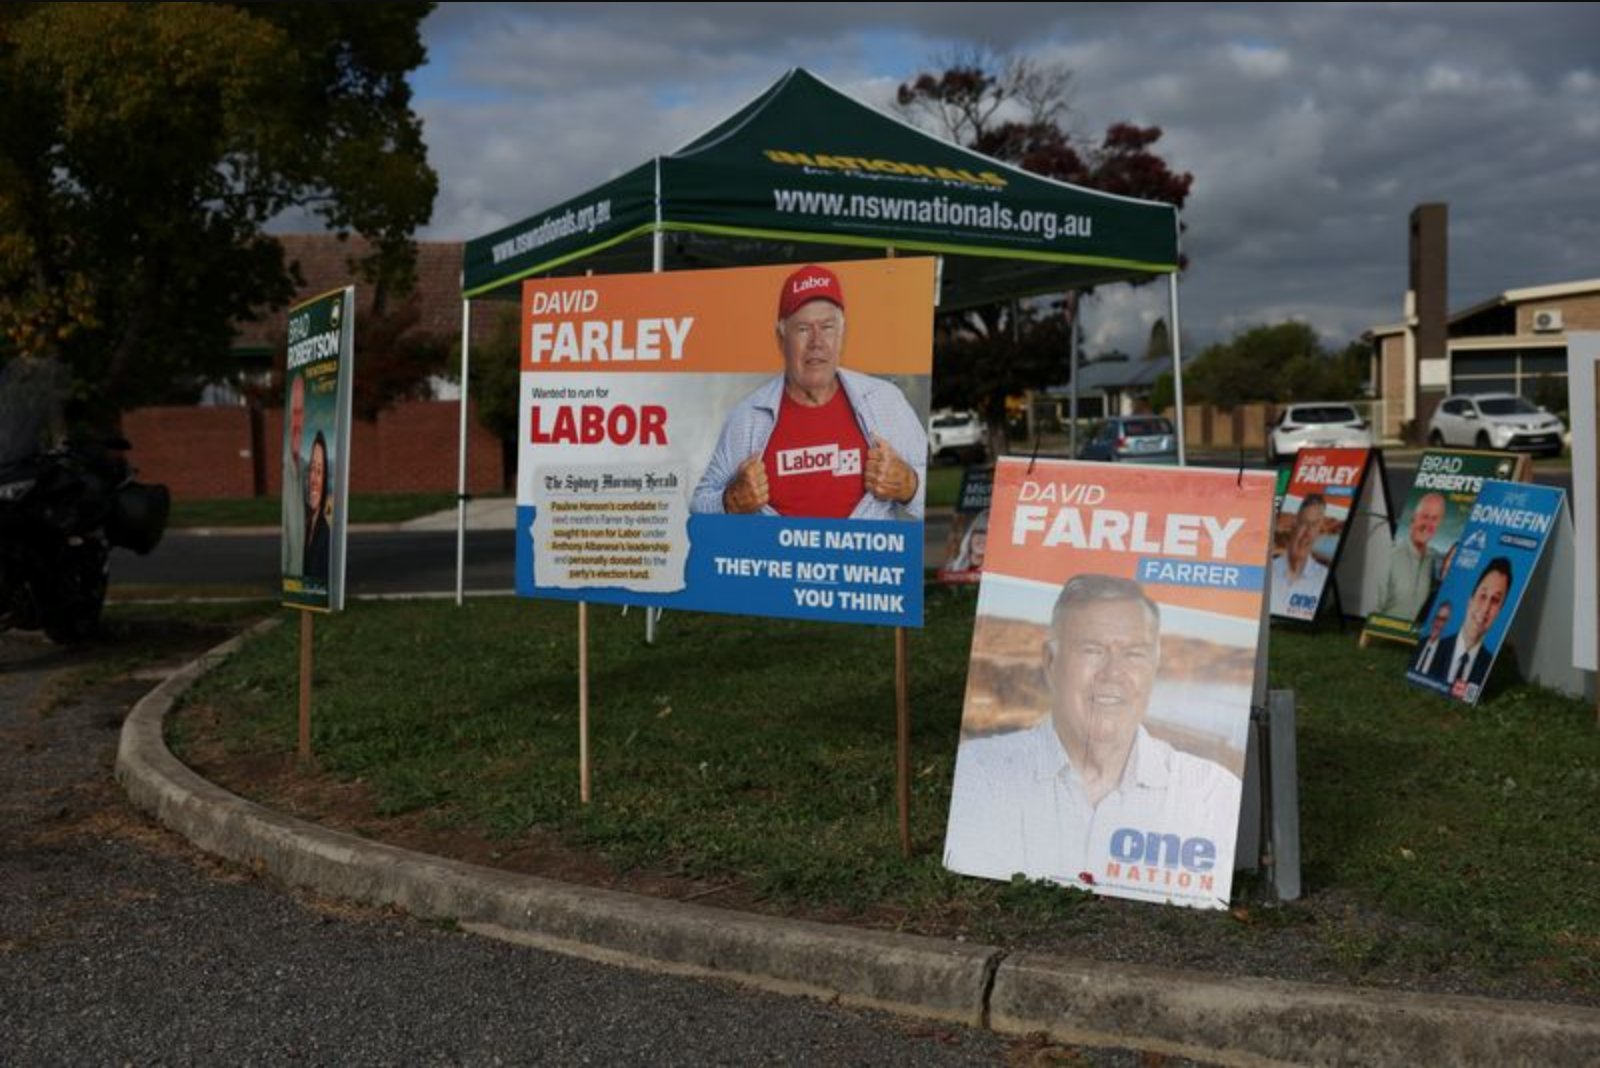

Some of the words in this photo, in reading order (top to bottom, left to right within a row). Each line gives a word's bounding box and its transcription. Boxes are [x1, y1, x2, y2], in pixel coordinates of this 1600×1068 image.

[773, 189, 1092, 239] www.nswnationals.org.au
[793, 276, 831, 293] Labor
[532, 289, 599, 315] DAVID
[287, 329, 340, 370] ROBERTSON
[531, 317, 694, 364] FARLEY
[532, 388, 566, 399] Wanted
[567, 388, 577, 399] to
[578, 390, 594, 399] run
[596, 387, 609, 399] for
[530, 404, 668, 445] LABOR
[782, 452, 834, 471] Labor
[1420, 455, 1463, 473] BRAD
[544, 475, 563, 490] The
[565, 474, 598, 493] Sydney
[602, 474, 642, 492] Morning
[645, 472, 677, 490] Herald
[1295, 465, 1359, 485] FARLEY
[1414, 473, 1509, 493] ROBERTS
[1018, 481, 1105, 505] DAVID
[616, 501, 656, 511] candidate
[1470, 503, 1551, 533] BONNEFIN
[618, 529, 641, 538] Labor
[778, 529, 821, 548] ONE
[825, 531, 905, 553] NATION
[1011, 504, 1245, 559] FARLEY
[714, 557, 793, 579] THEY'RE
[796, 561, 839, 583] NOT
[843, 565, 905, 586] WHAT
[1145, 561, 1239, 585] FARRER
[793, 588, 834, 608] YOU
[838, 591, 905, 613] THINK
[1109, 827, 1217, 873] one
[1107, 862, 1215, 891] NATION
